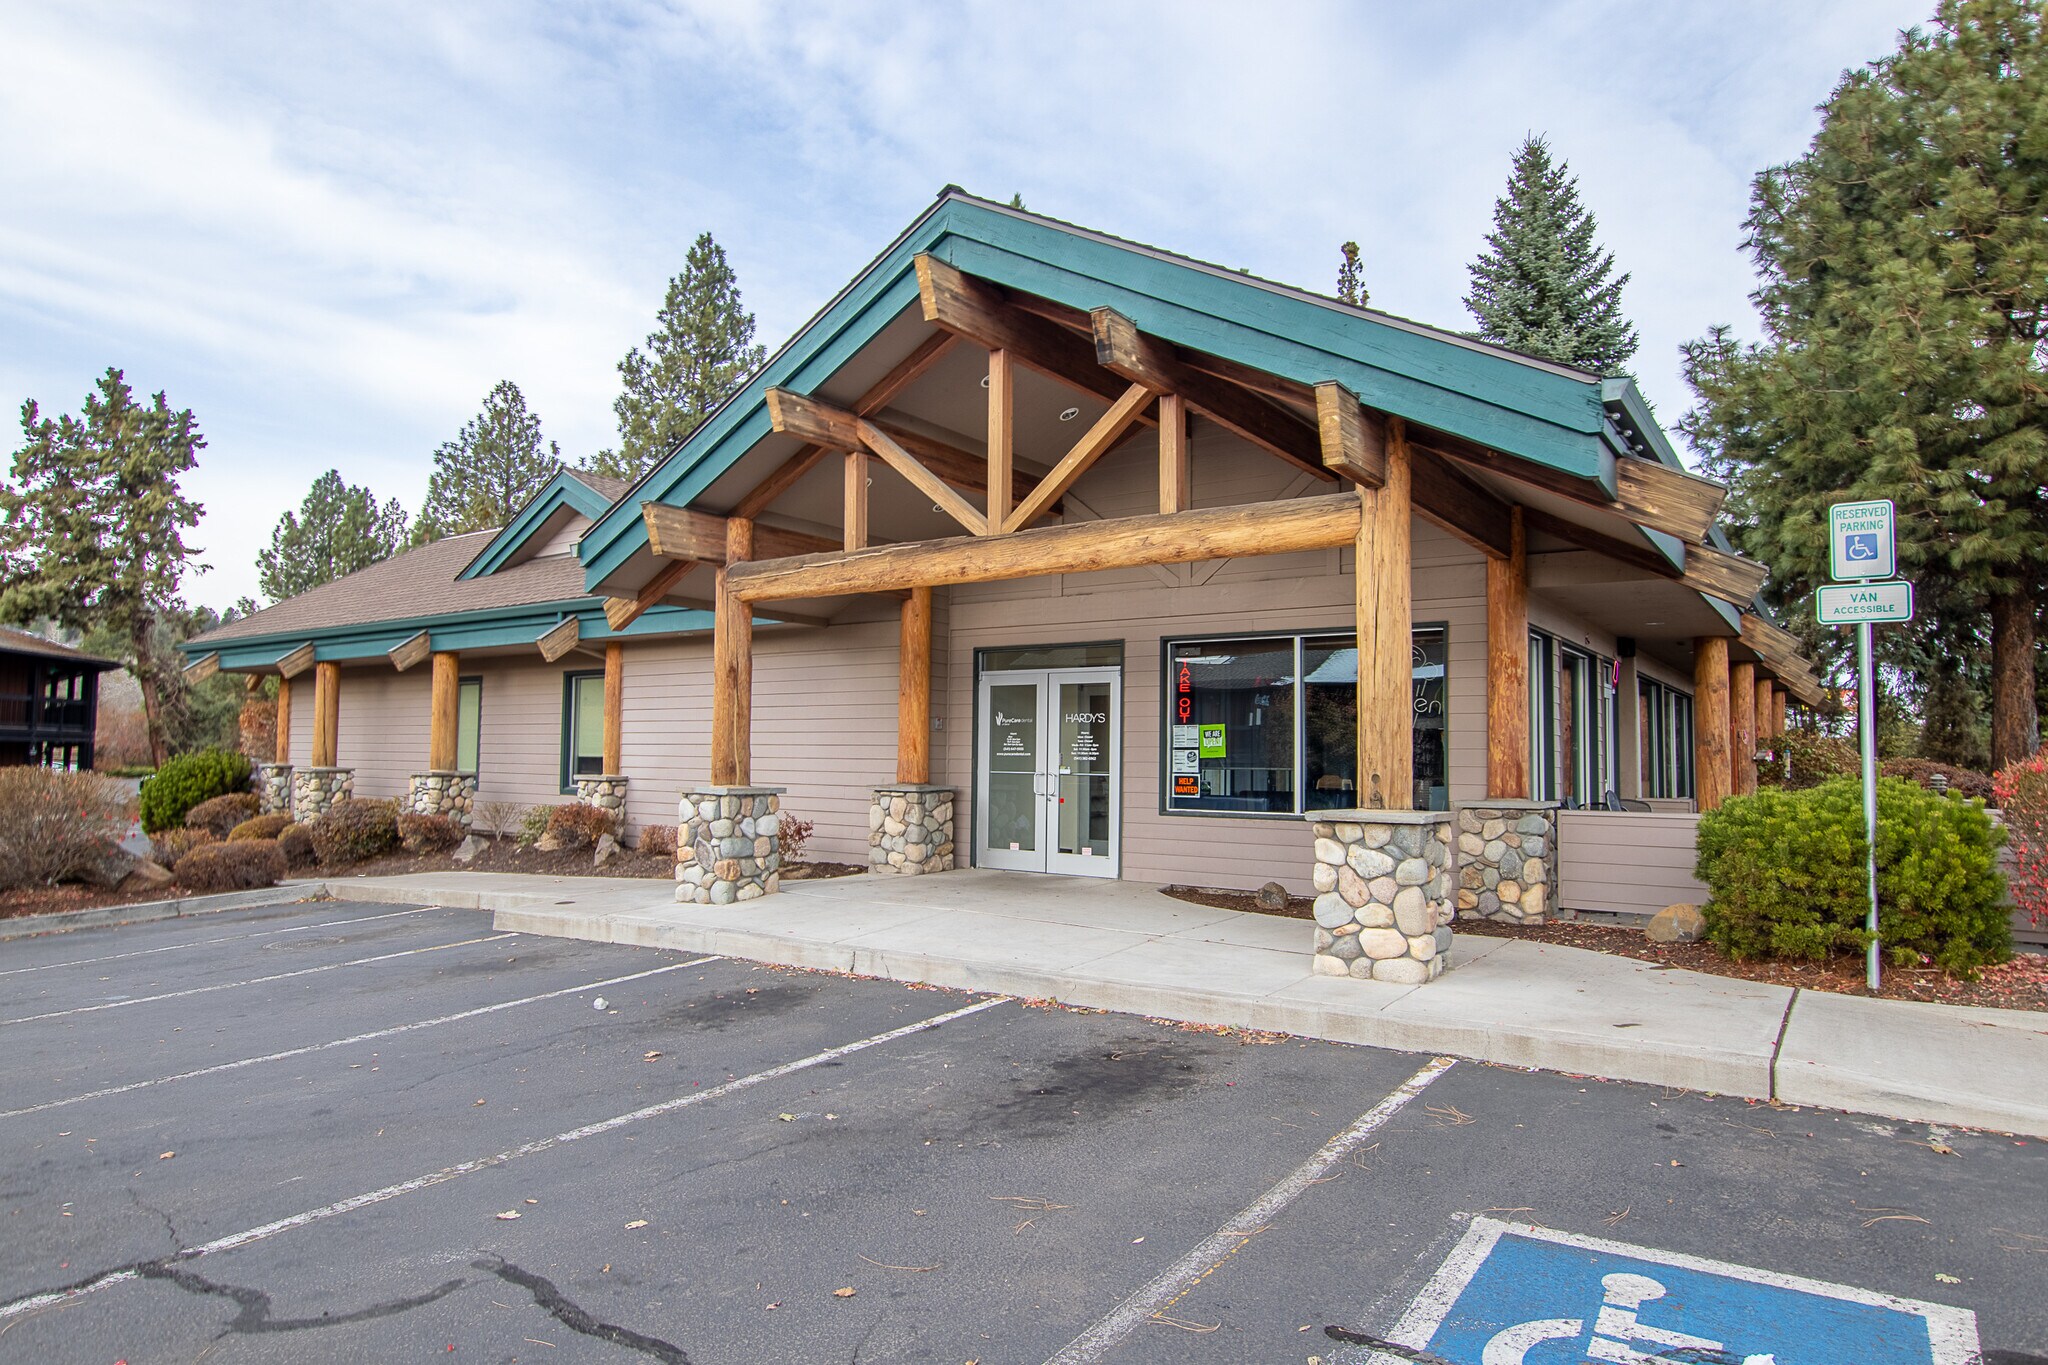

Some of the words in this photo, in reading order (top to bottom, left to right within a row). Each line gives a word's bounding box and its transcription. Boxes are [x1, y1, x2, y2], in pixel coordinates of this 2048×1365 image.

[1835, 507, 1887, 520] RESERVED
[1840, 520, 1884, 532] PARKING
[1850, 592, 1877, 603] VAN
[1833, 604, 1895, 615] ACCESSIBLE
[1179, 697, 1191, 723] OUT
[1178, 777, 1194, 785] HELP
[1175, 785, 1198, 793] WANTED
